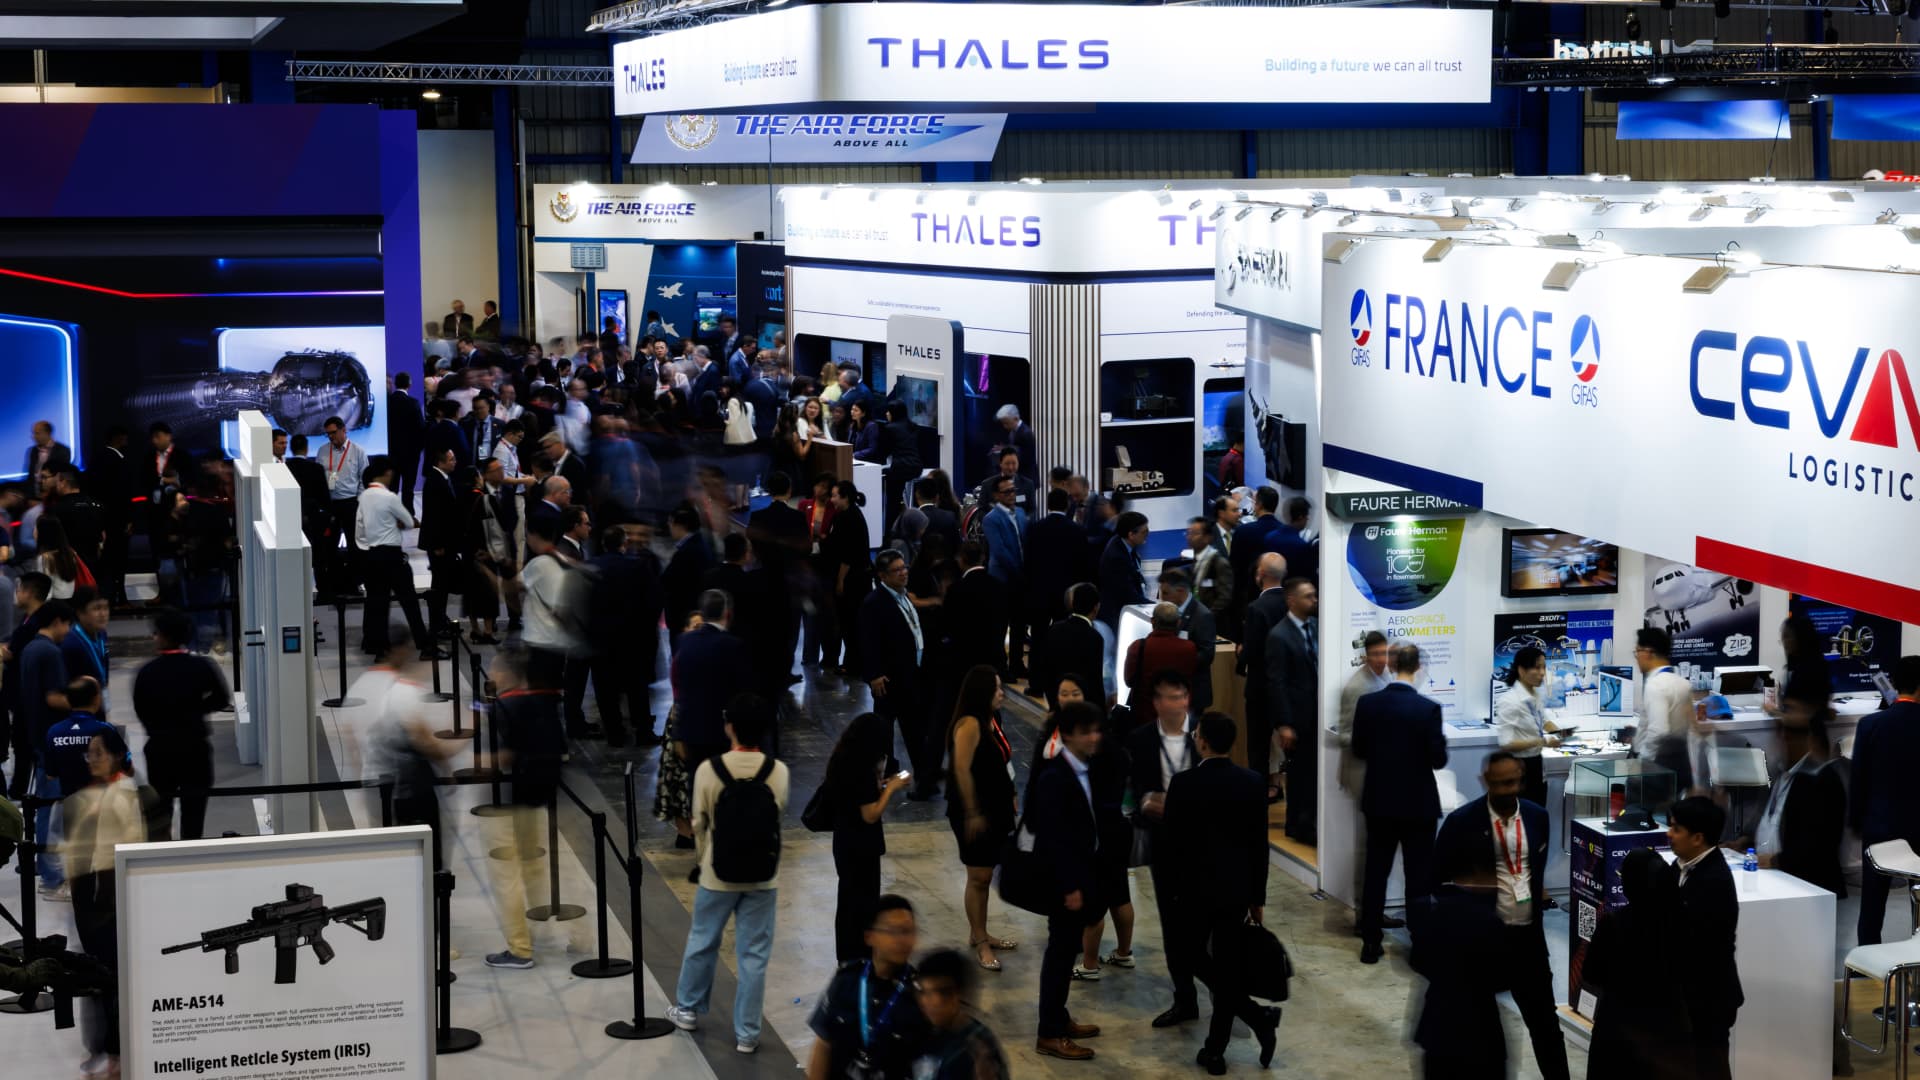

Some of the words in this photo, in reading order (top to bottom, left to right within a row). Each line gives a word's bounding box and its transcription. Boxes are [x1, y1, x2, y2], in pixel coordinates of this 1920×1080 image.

[867, 37, 1110, 70] THALES
[1265, 58, 1317, 74] Building
[1320, 61, 1328, 72] a
[1331, 58, 1371, 72] future
[1373, 61, 1390, 72] we
[1394, 61, 1415, 72] can
[1418, 58, 1431, 72] all
[1434, 59, 1462, 72] trust
[623, 58, 666, 93] THALES
[735, 114, 789, 135] THE
[791, 114, 845, 135] AIR
[848, 114, 945, 135] FORCE
[833, 139, 880, 147] ABOVE
[885, 139, 909, 147] ALL
[587, 202, 614, 215] THE
[615, 202, 642, 215] AIR
[644, 202, 697, 216] FORCE
[911, 212, 1041, 248] THALES
[897, 343, 941, 360] THALES
[1385, 293, 1553, 399] FRANCE
[1351, 347, 1370, 368] GIFAS
[1571, 383, 1598, 408] GIFAS
[1789, 452, 1920, 502] LOGISTIC
[1350, 496, 1400, 511] FAURE
[1408, 526, 1448, 535] Herman
[1388, 614, 1446, 625] AEROSPACE
[1387, 625, 1456, 638] FLOWMETERS
[1729, 638, 1747, 650] ZIP
[1611, 849, 1631, 859] CEV
[152, 994, 225, 1012] AME-A514
[154, 1055, 228, 1074] Intelligent
[230, 1050, 279, 1067] Reticle
[281, 1048, 331, 1066] System
[334, 1042, 371, 1060] (IRIS)
